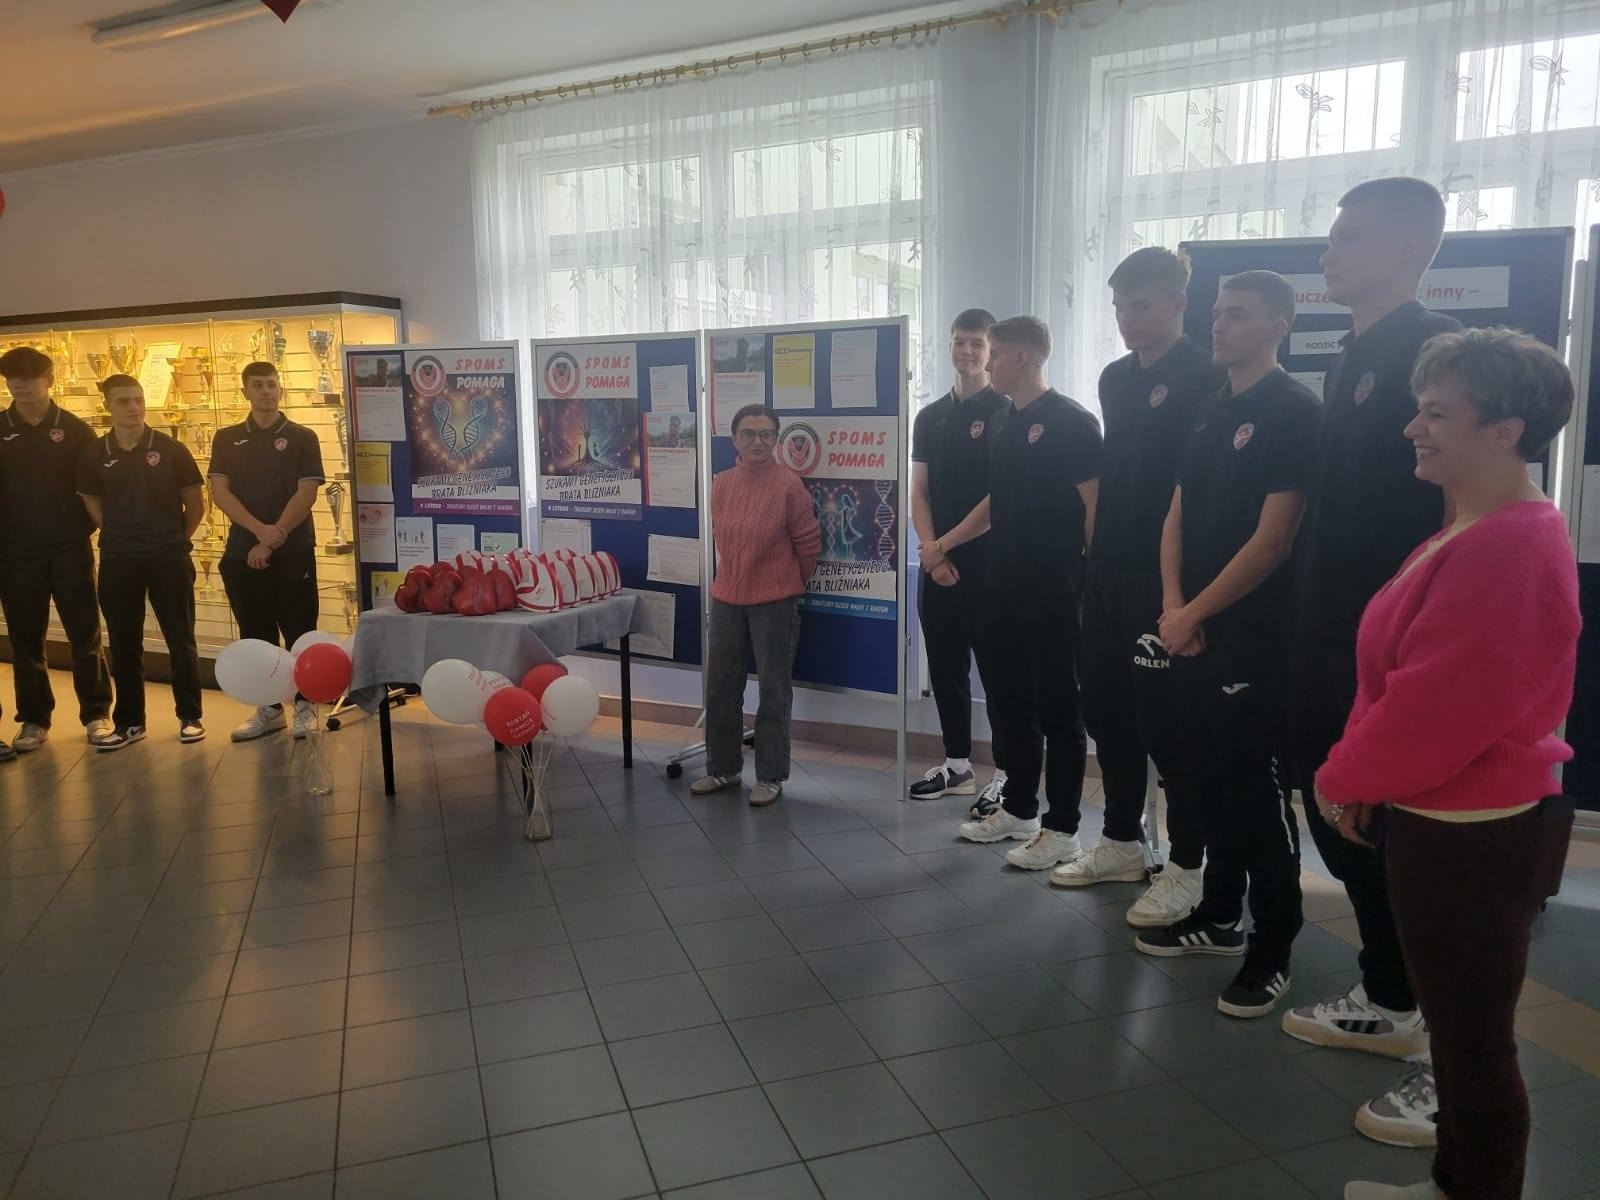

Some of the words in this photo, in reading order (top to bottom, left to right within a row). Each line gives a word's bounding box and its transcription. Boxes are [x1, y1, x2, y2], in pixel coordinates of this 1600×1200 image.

[1427, 284, 1464, 302] inny
[455, 357, 505, 371] SPOMS
[585, 356, 631, 370] SPOMS
[456, 375, 505, 389] POMAGA
[585, 375, 631, 389] POMAGA
[828, 430, 887, 445] SPOMS
[828, 452, 885, 467] POMAGA
[1133, 655, 1170, 669] ORLEN
